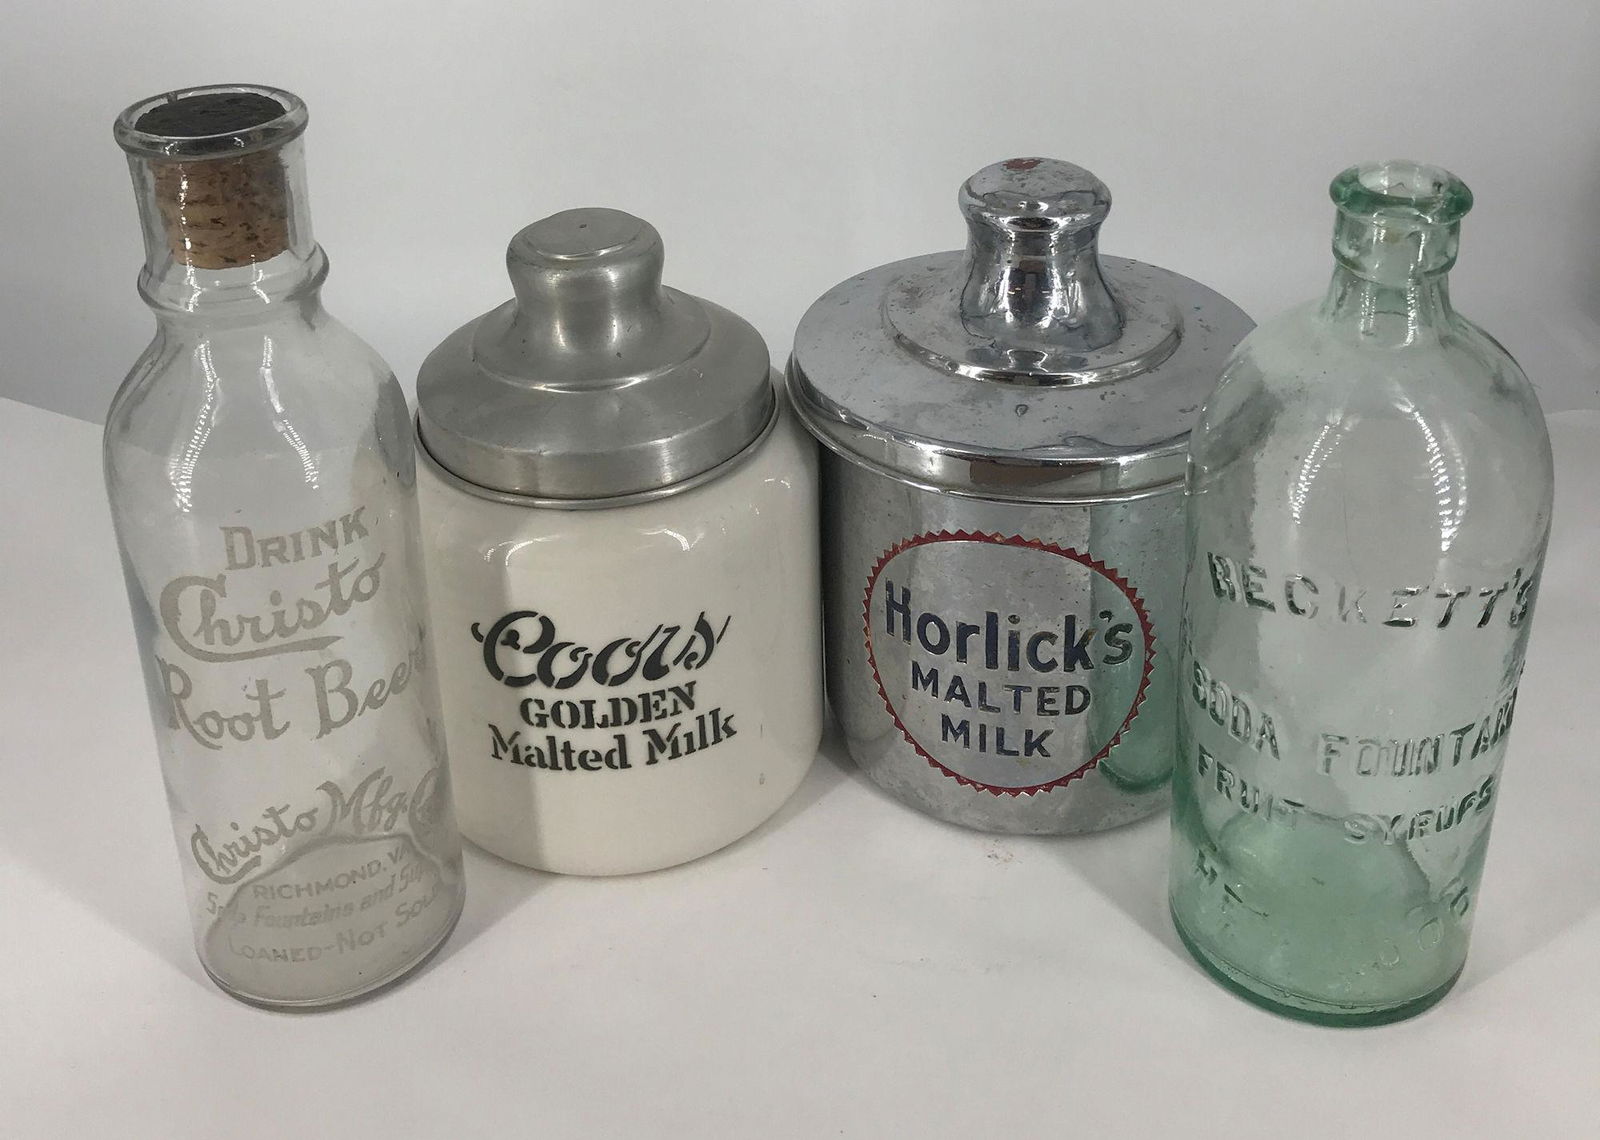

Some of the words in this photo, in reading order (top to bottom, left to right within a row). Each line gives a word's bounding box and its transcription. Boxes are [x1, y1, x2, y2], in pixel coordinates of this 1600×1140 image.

[219, 506, 369, 571] DRINK
[160, 552, 386, 663] Christo
[885, 579, 1134, 673] Horlick's
[471, 610, 731, 690] Coors
[911, 661, 1092, 717] MALTED
[155, 655, 291, 751] Root
[305, 648, 420, 741] Bee
[488, 723, 632, 771] Malted
[642, 707, 738, 766] Milk
[520, 681, 697, 729] GOLDEN
[941, 713, 1055, 758] MILK
[1192, 660, 1281, 762] SODA
[190, 803, 319, 885] Christo
